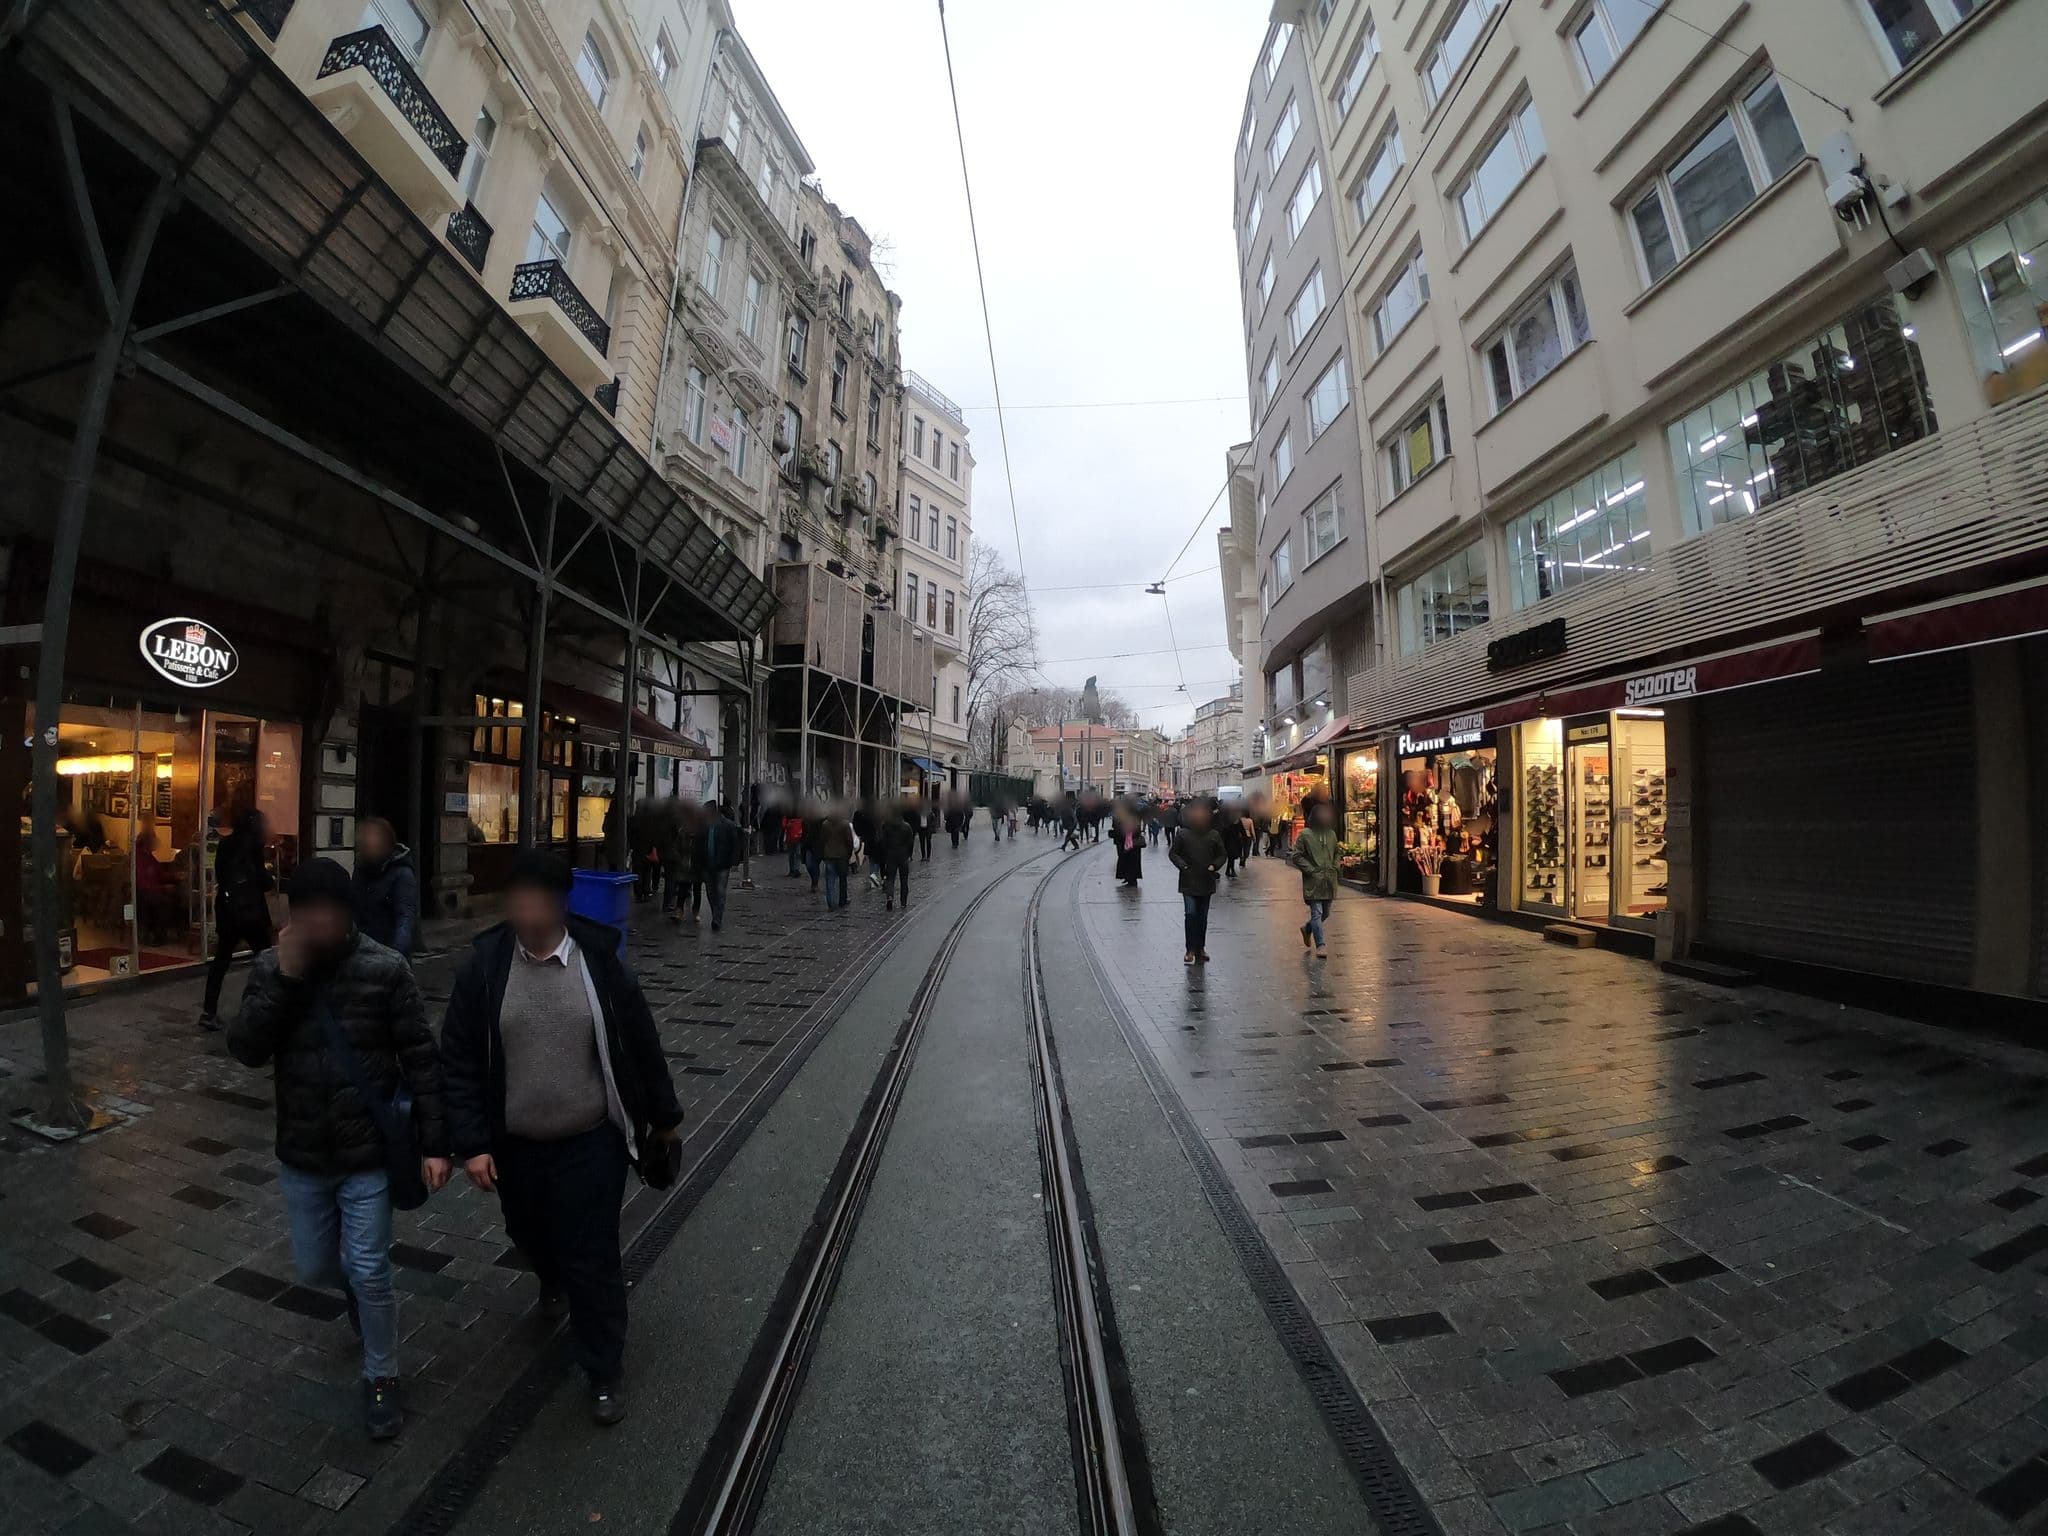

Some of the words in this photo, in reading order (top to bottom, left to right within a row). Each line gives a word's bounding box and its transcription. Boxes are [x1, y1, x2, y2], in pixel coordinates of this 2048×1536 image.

[153, 634, 231, 671] LEBON
[163, 658, 196, 675] Patisserie
[1625, 666, 1697, 705] SCOOTER
[1448, 712, 1484, 737] SCOOTER
